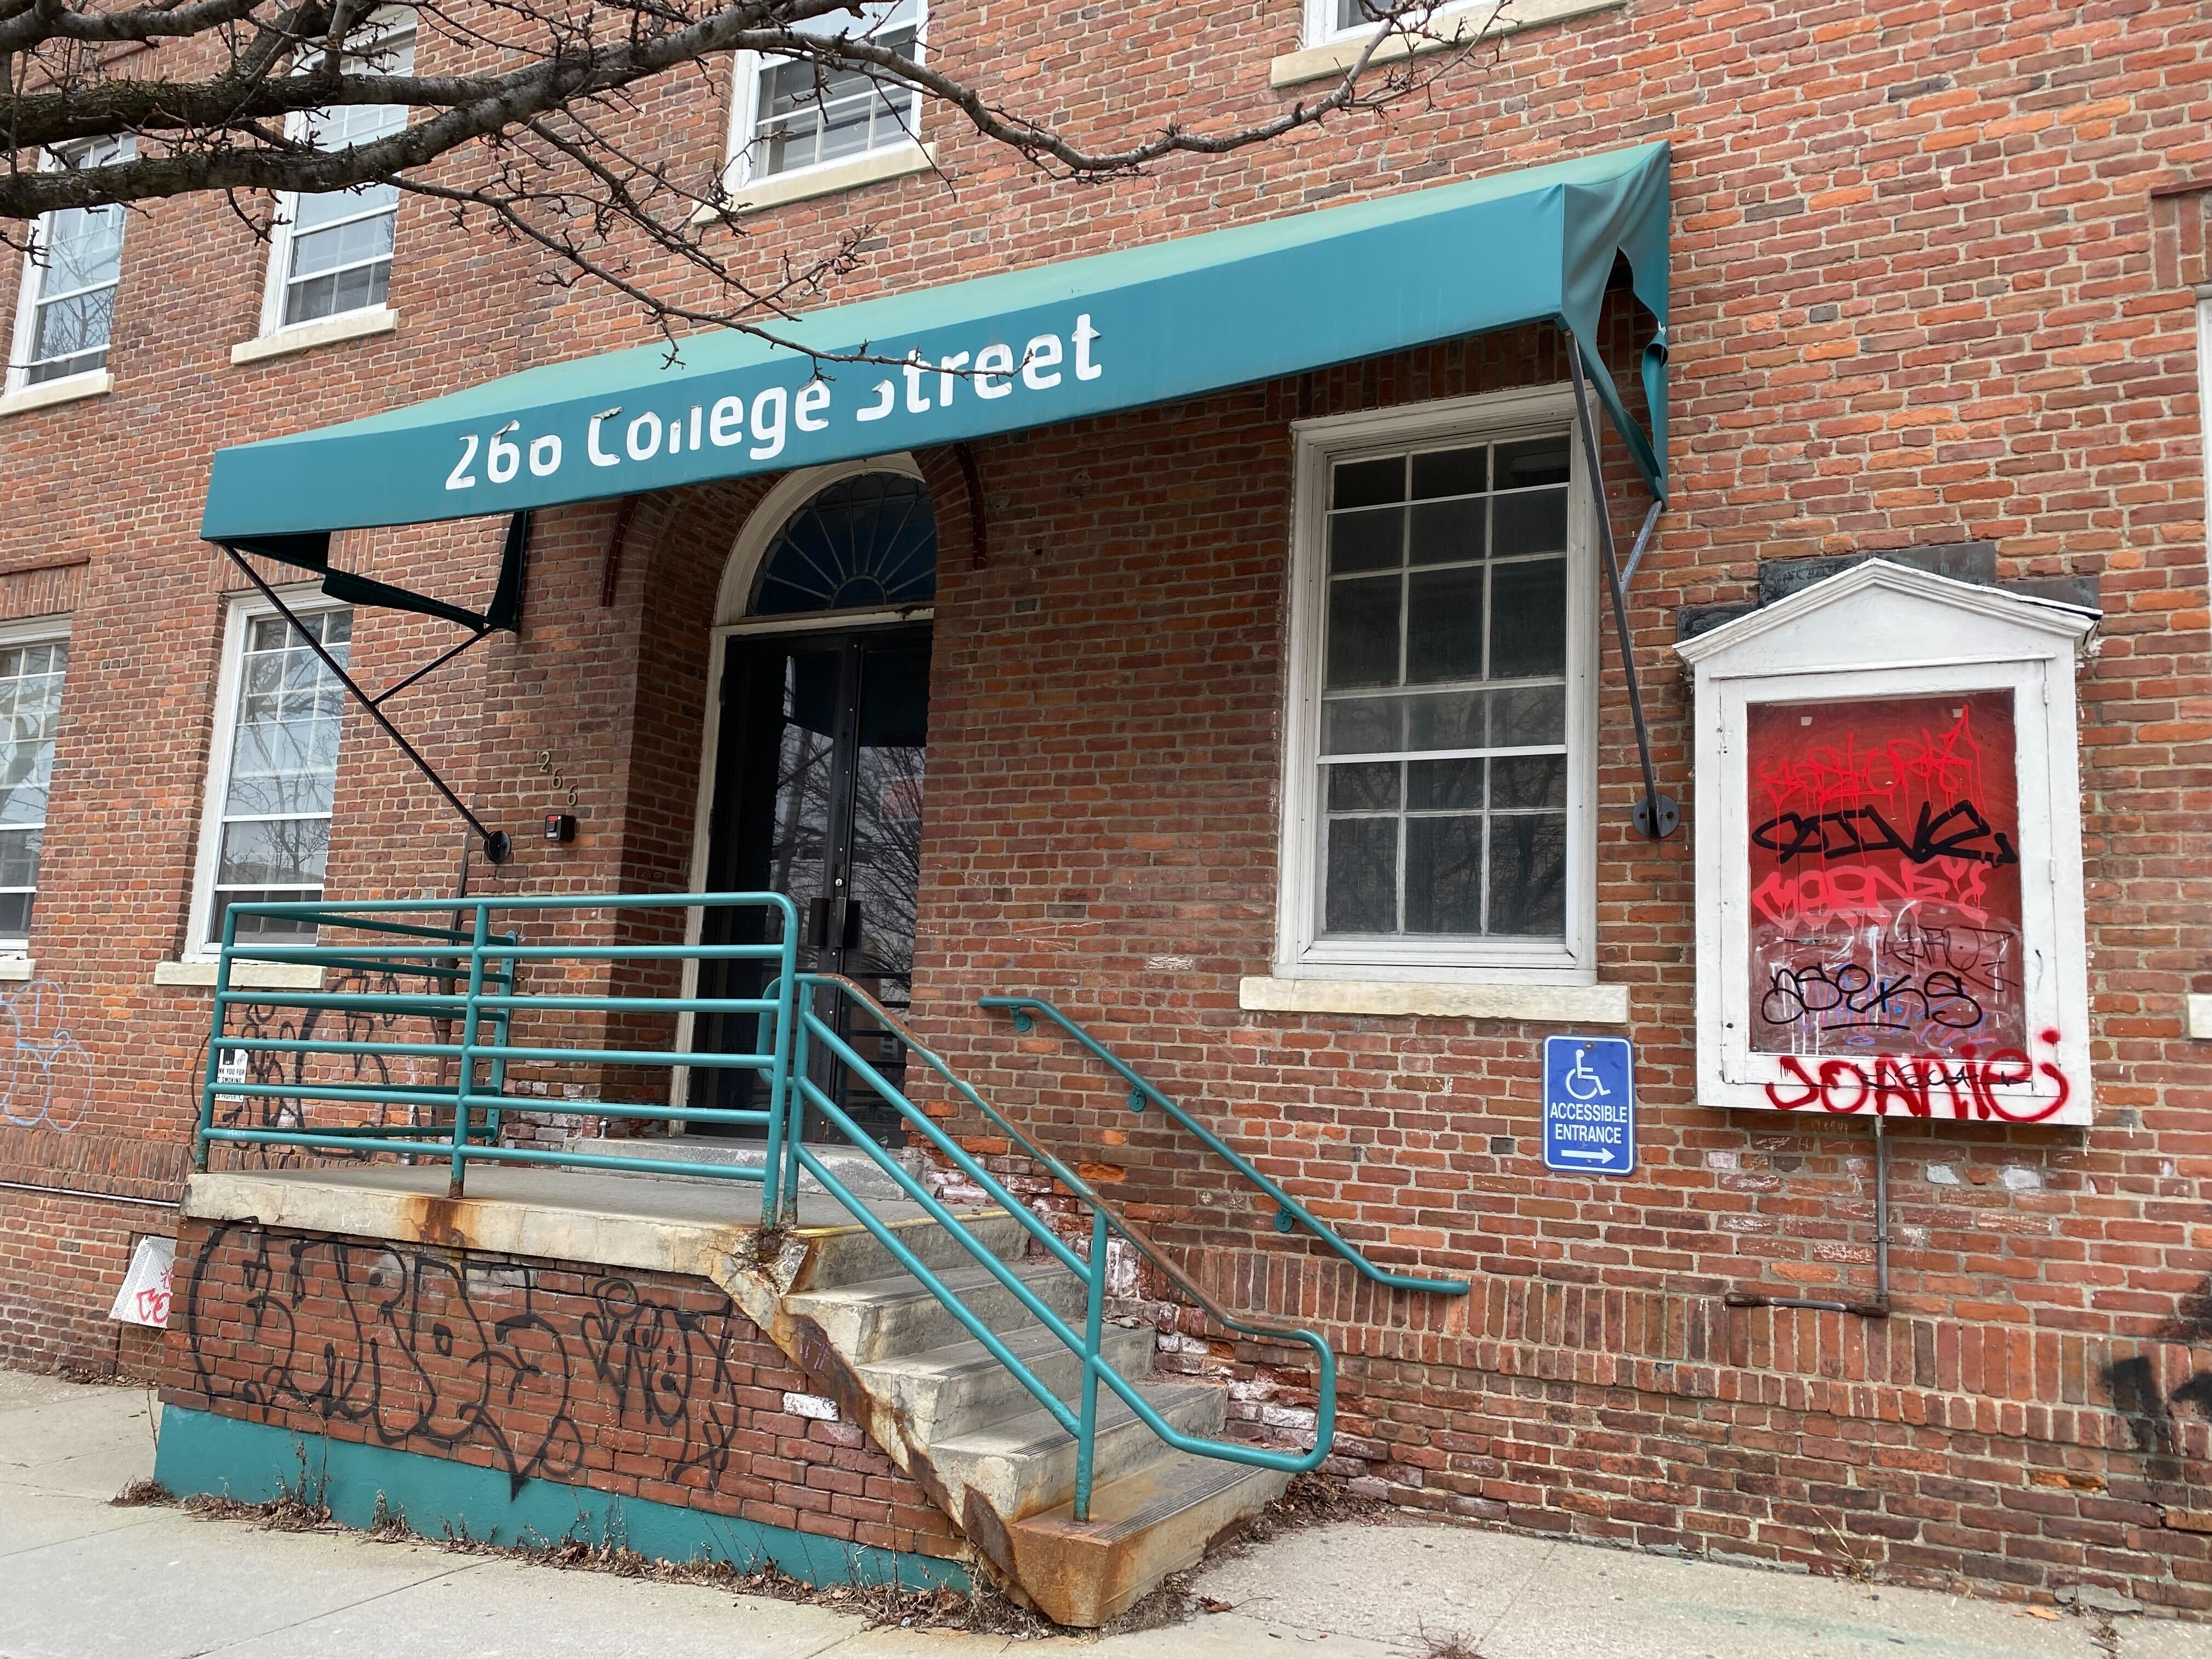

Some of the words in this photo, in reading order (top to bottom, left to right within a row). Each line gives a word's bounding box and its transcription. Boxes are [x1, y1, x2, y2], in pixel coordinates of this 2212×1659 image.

[445, 420, 562, 490] 260
[539, 751, 578, 806] 266
[1550, 1102, 1628, 1124] ACCESSIBLE
[1555, 1123, 1622, 1144] ENTRANCE
